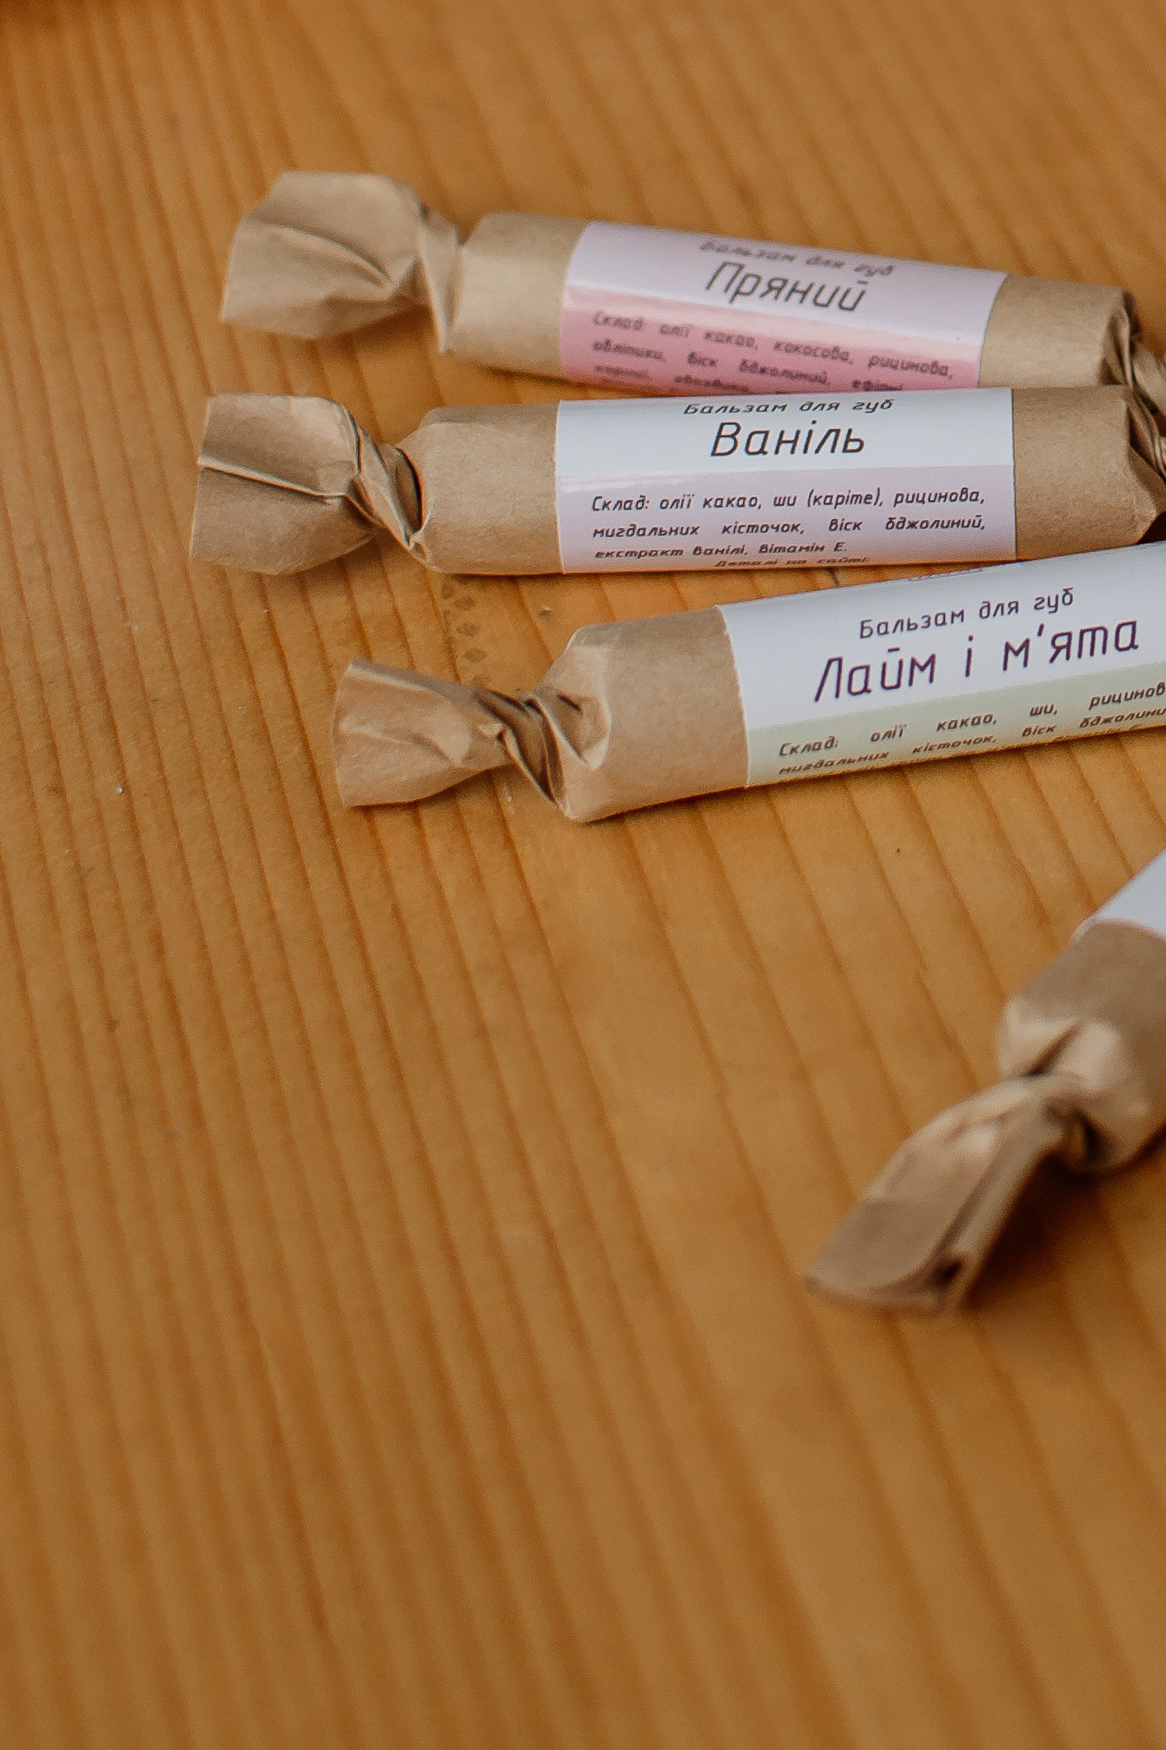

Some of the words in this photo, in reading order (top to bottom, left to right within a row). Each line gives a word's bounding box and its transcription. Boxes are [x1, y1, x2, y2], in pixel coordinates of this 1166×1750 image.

[705, 261, 868, 311] Пряний
[867, 355, 953, 380] рицинова,
[683, 404, 788, 415] Бальзам
[799, 401, 841, 412] для
[852, 399, 894, 414] губ
[710, 419, 865, 457] Ваніль
[592, 494, 650, 512] Склад:
[659, 494, 695, 510] олії
[702, 495, 762, 510] какао,
[773, 495, 798, 507] ши
[806, 487, 884, 510] (каріте),
[893, 487, 986, 509] рицинова,
[592, 524, 700, 539] мигдальних
[721, 521, 805, 535] кісточок,
[828, 518, 863, 533] віск
[884, 515, 986, 531] бджолиний,
[594, 548, 684, 560] екстракт
[758, 542, 826, 554] вітамін
[859, 608, 965, 639] Бальзам
[978, 599, 1019, 619] для
[1033, 587, 1074, 614] губ
[814, 647, 937, 702] Лайм
[964, 635, 974, 677] і
[779, 735, 838, 757] Склад:
[870, 723, 908, 742] олії
[937, 713, 997, 732] какао,
[1029, 703, 1058, 717] ши,
[779, 751, 890, 775] мигдальних
[1022, 724, 1056, 737] віск
